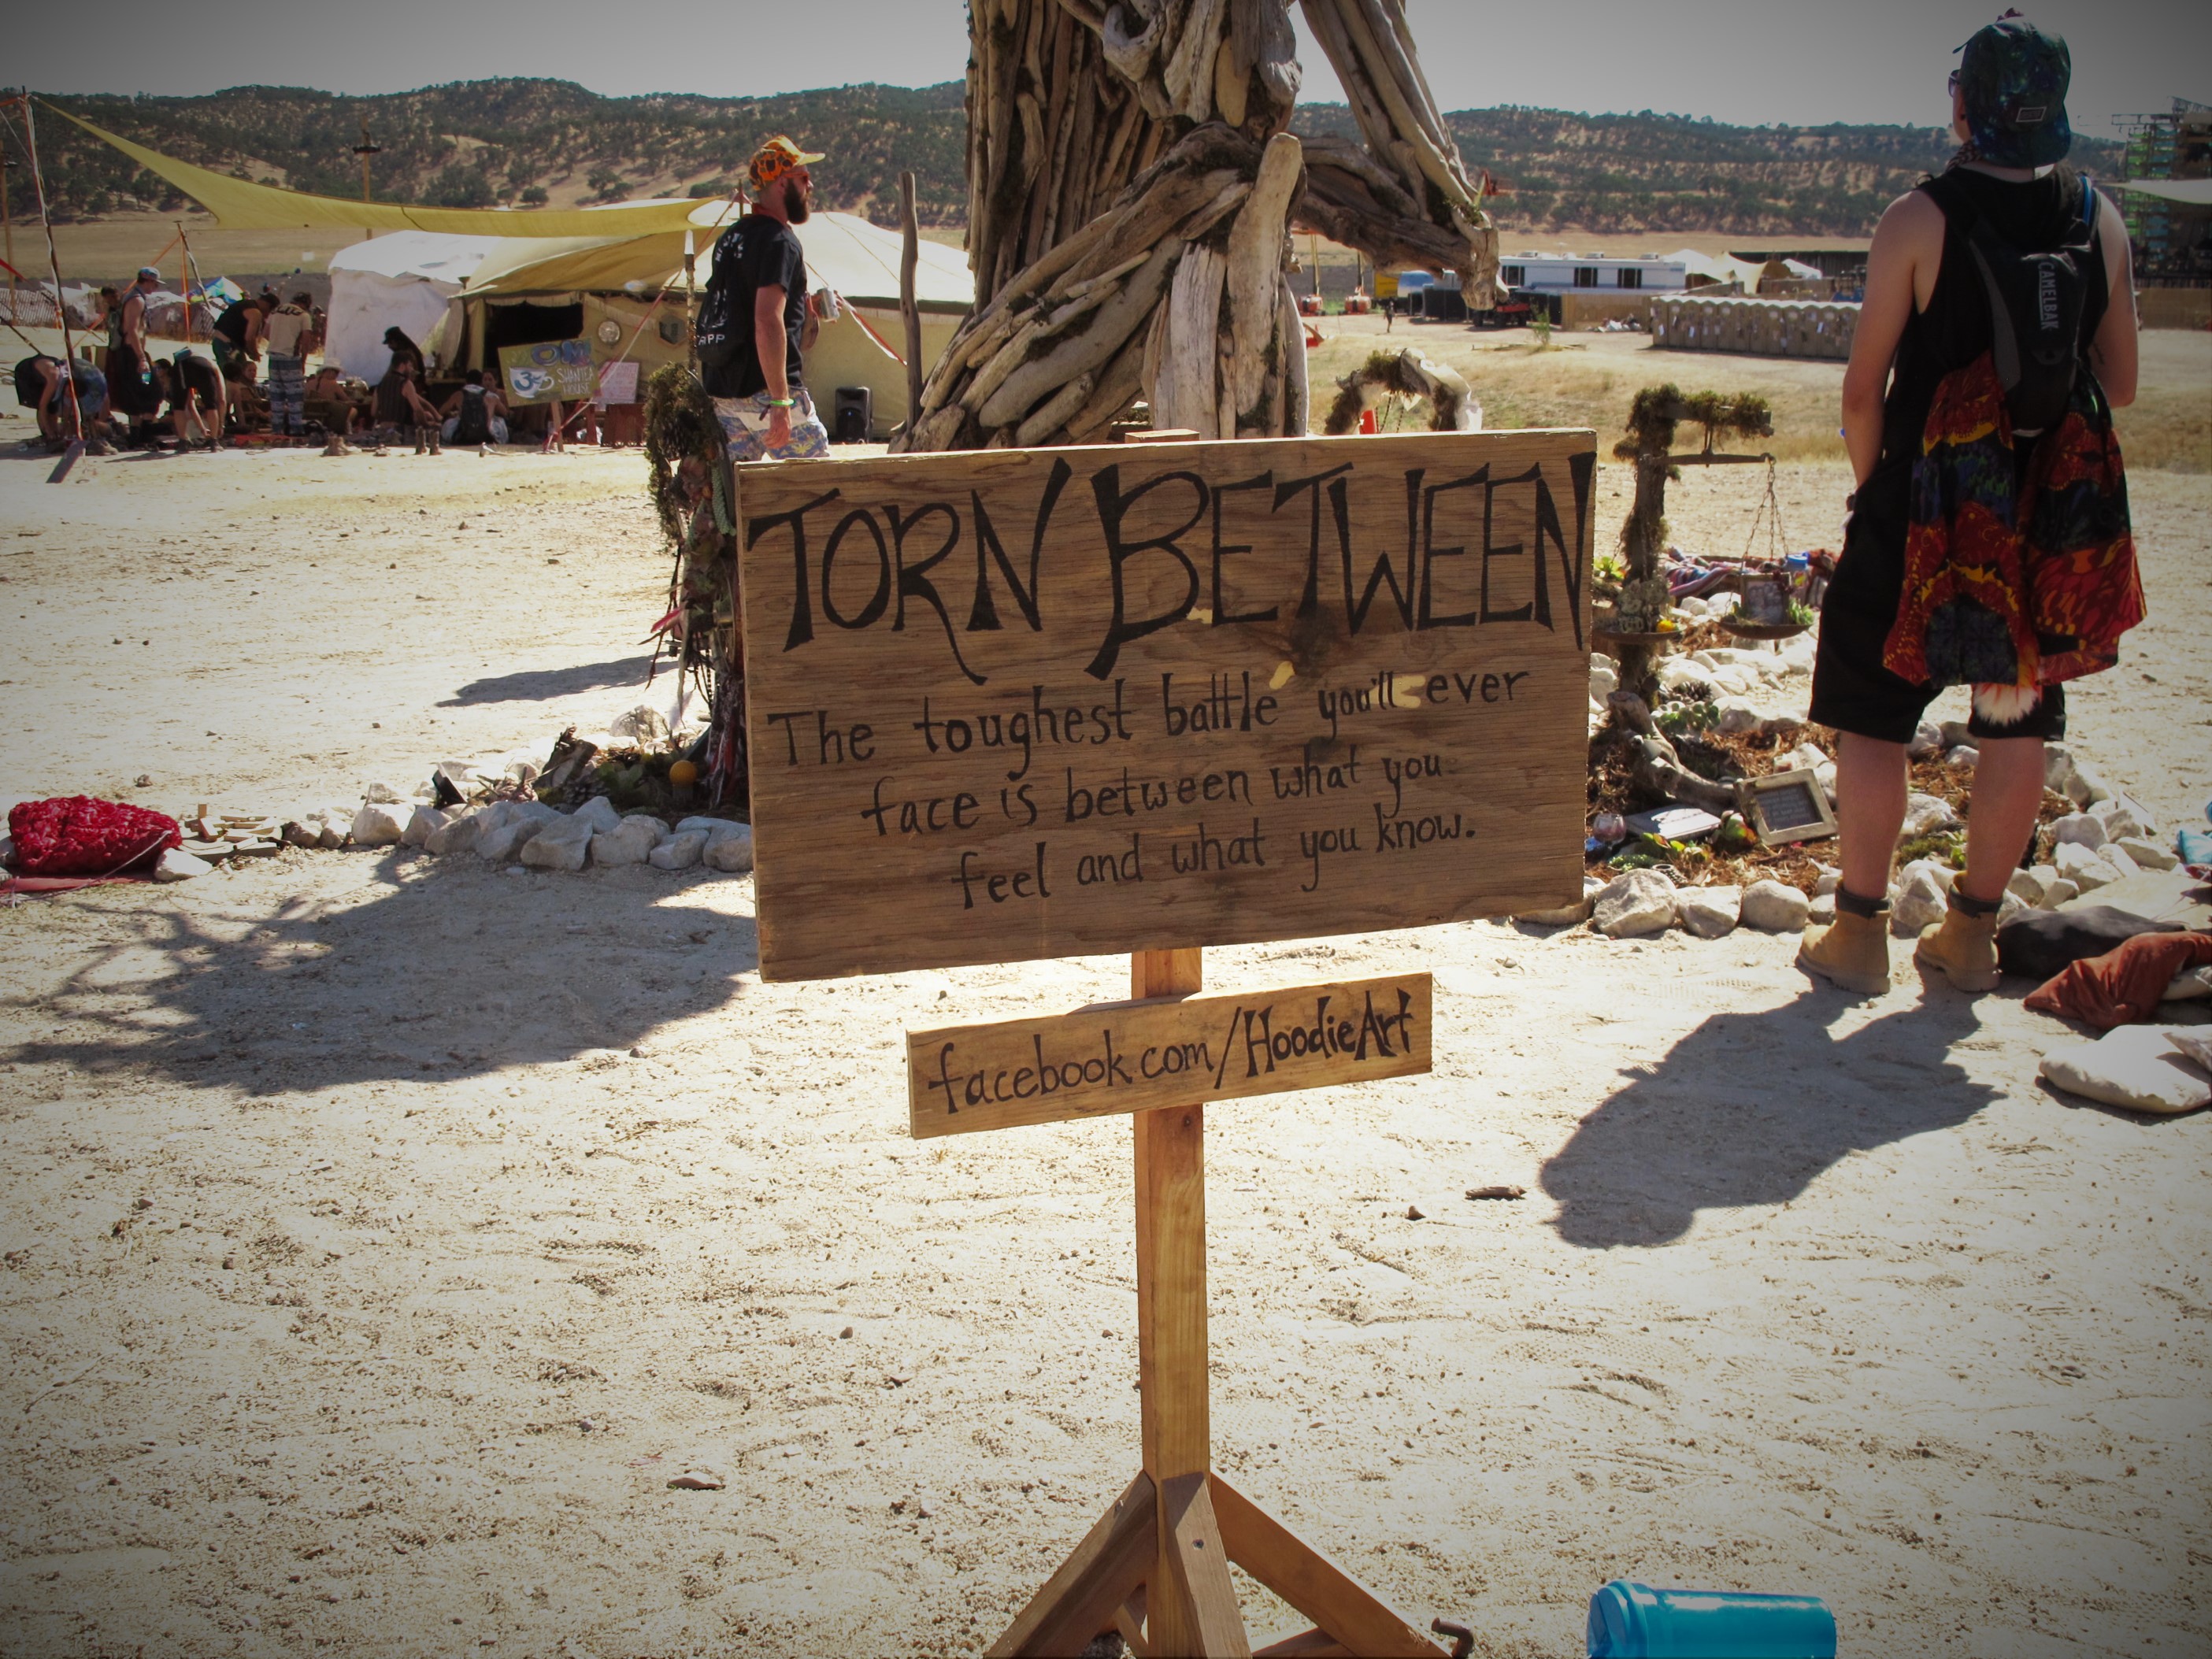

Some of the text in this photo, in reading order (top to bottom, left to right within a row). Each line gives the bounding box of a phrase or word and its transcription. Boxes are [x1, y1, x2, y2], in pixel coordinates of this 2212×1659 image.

[2037, 261, 2059, 330] CAMELBAK
[562, 383, 590, 395] HOUSE
[747, 450, 1597, 686] TORN BETWEEN
[767, 670, 1530, 781] The toughest battle you'll ever
[861, 743, 1442, 836] face is between what you
[950, 802, 1477, 910] feel and what you know.
